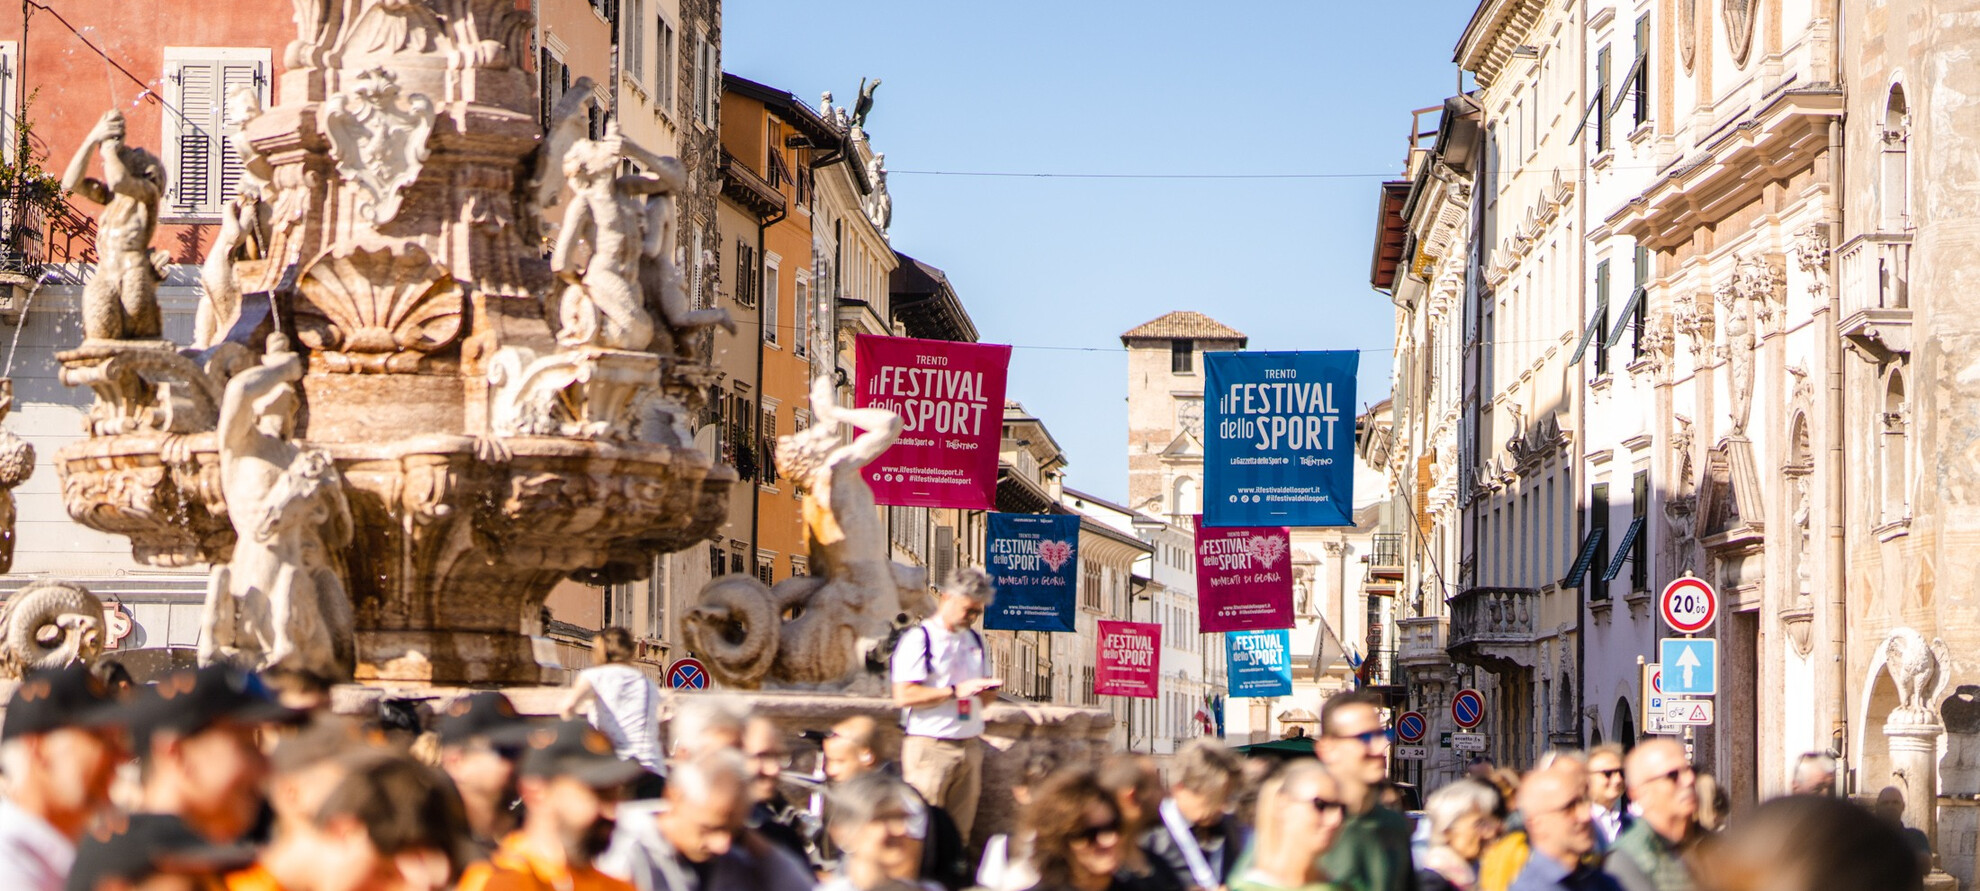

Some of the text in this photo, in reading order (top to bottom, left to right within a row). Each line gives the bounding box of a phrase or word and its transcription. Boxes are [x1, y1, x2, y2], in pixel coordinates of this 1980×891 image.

[916, 355, 948, 366] TRENTO
[1265, 369, 1297, 379] TRENTO
[869, 366, 988, 402] il FESTIVAL
[1220, 383, 1339, 414] il FESTIVAL
[903, 399, 988, 436] SPORT
[1220, 416, 1339, 450] dello SPORT
[882, 466, 963, 476] www.ilfestivaldellosport.it
[909, 475, 971, 485] #ilfestivaldellosport
[1238, 486, 1320, 494] www.ilfestivaldellosport.it
[1266, 495, 1328, 503] #ilfestivaldellosport
[995, 539, 1038, 554] FESTIVAL
[1204, 538, 1249, 554] FESTIVAL
[994, 554, 1041, 571] dello SPORT
[1204, 553, 1252, 571] dello SPORT
[999, 576, 1028, 586] MOMENTI
[1041, 576, 1066, 586] GLORIA
[1211, 574, 1240, 587] MOMENTI
[1254, 572, 1281, 583] GLORIA
[1108, 634, 1154, 651] FESTIVAL
[1236, 634, 1283, 650] FESTIVAL
[1118, 649, 1154, 666] SPORT
[1248, 649, 1284, 665] SPORT
